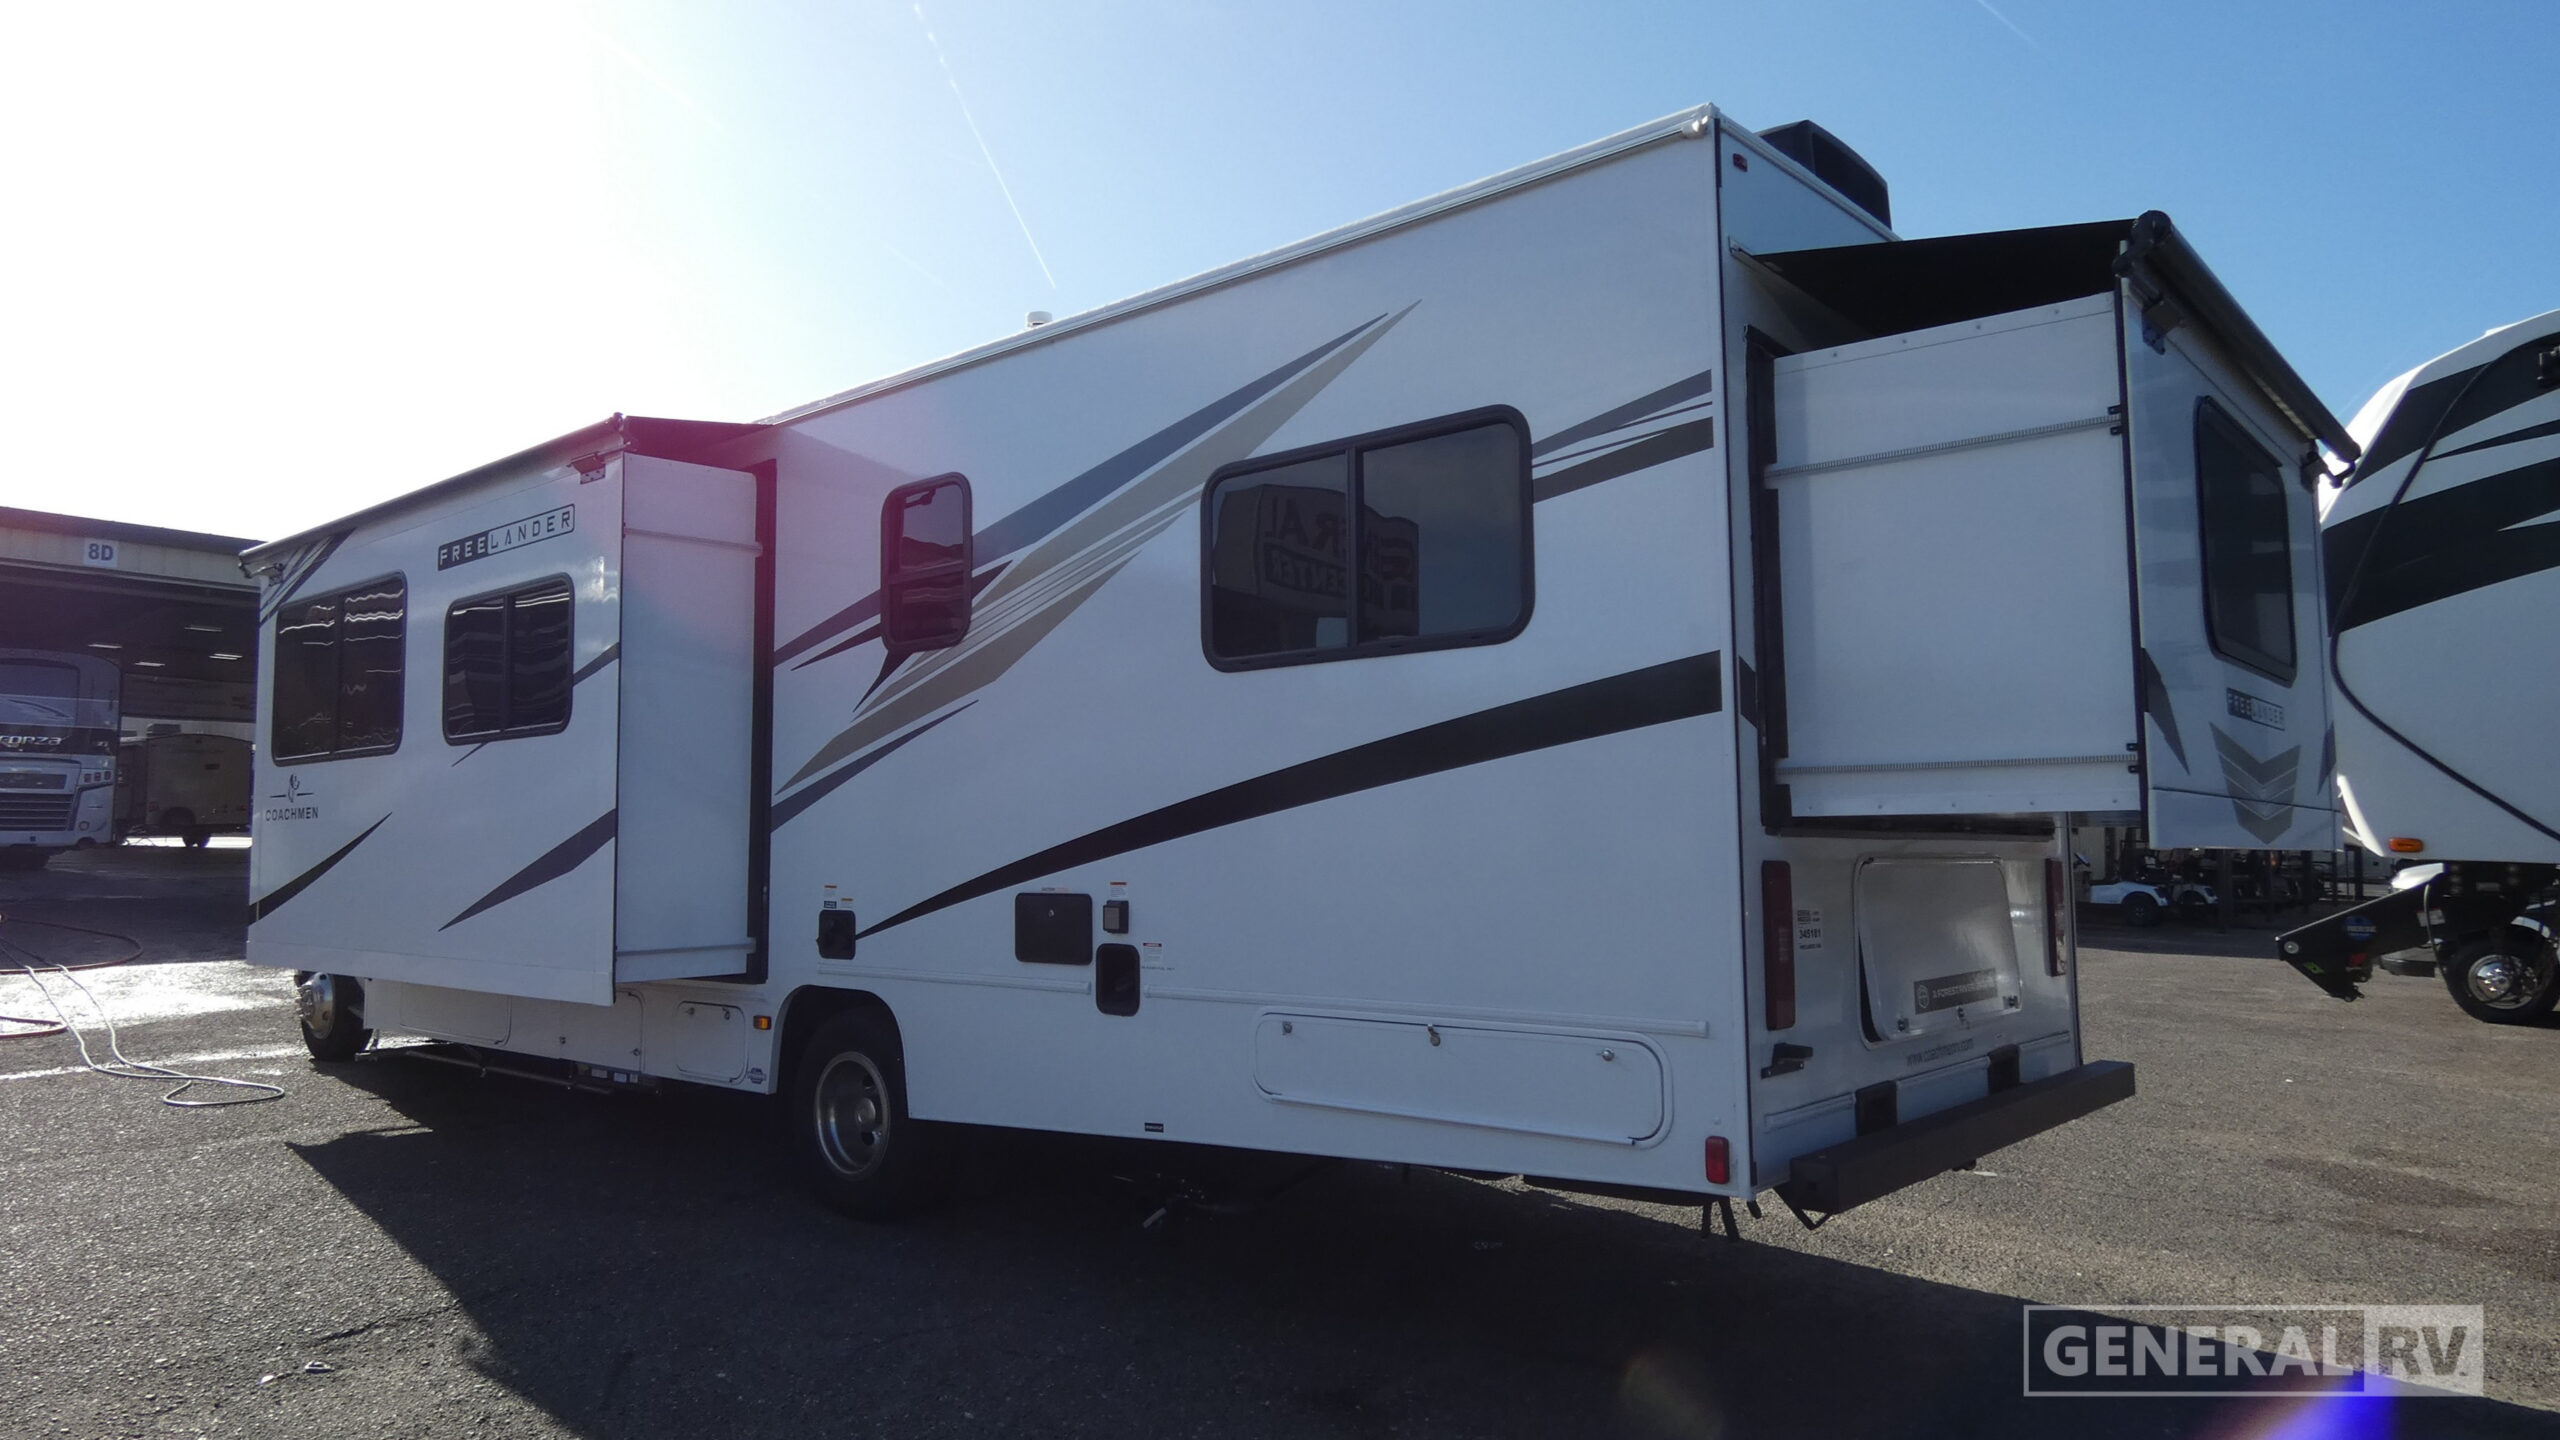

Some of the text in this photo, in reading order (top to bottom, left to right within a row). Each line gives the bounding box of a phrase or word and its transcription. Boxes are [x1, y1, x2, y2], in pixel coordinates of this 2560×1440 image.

[440, 510, 571, 566] FREELANDER
[88, 543, 114, 561] 8D
[265, 807, 319, 821] COACHMEN
